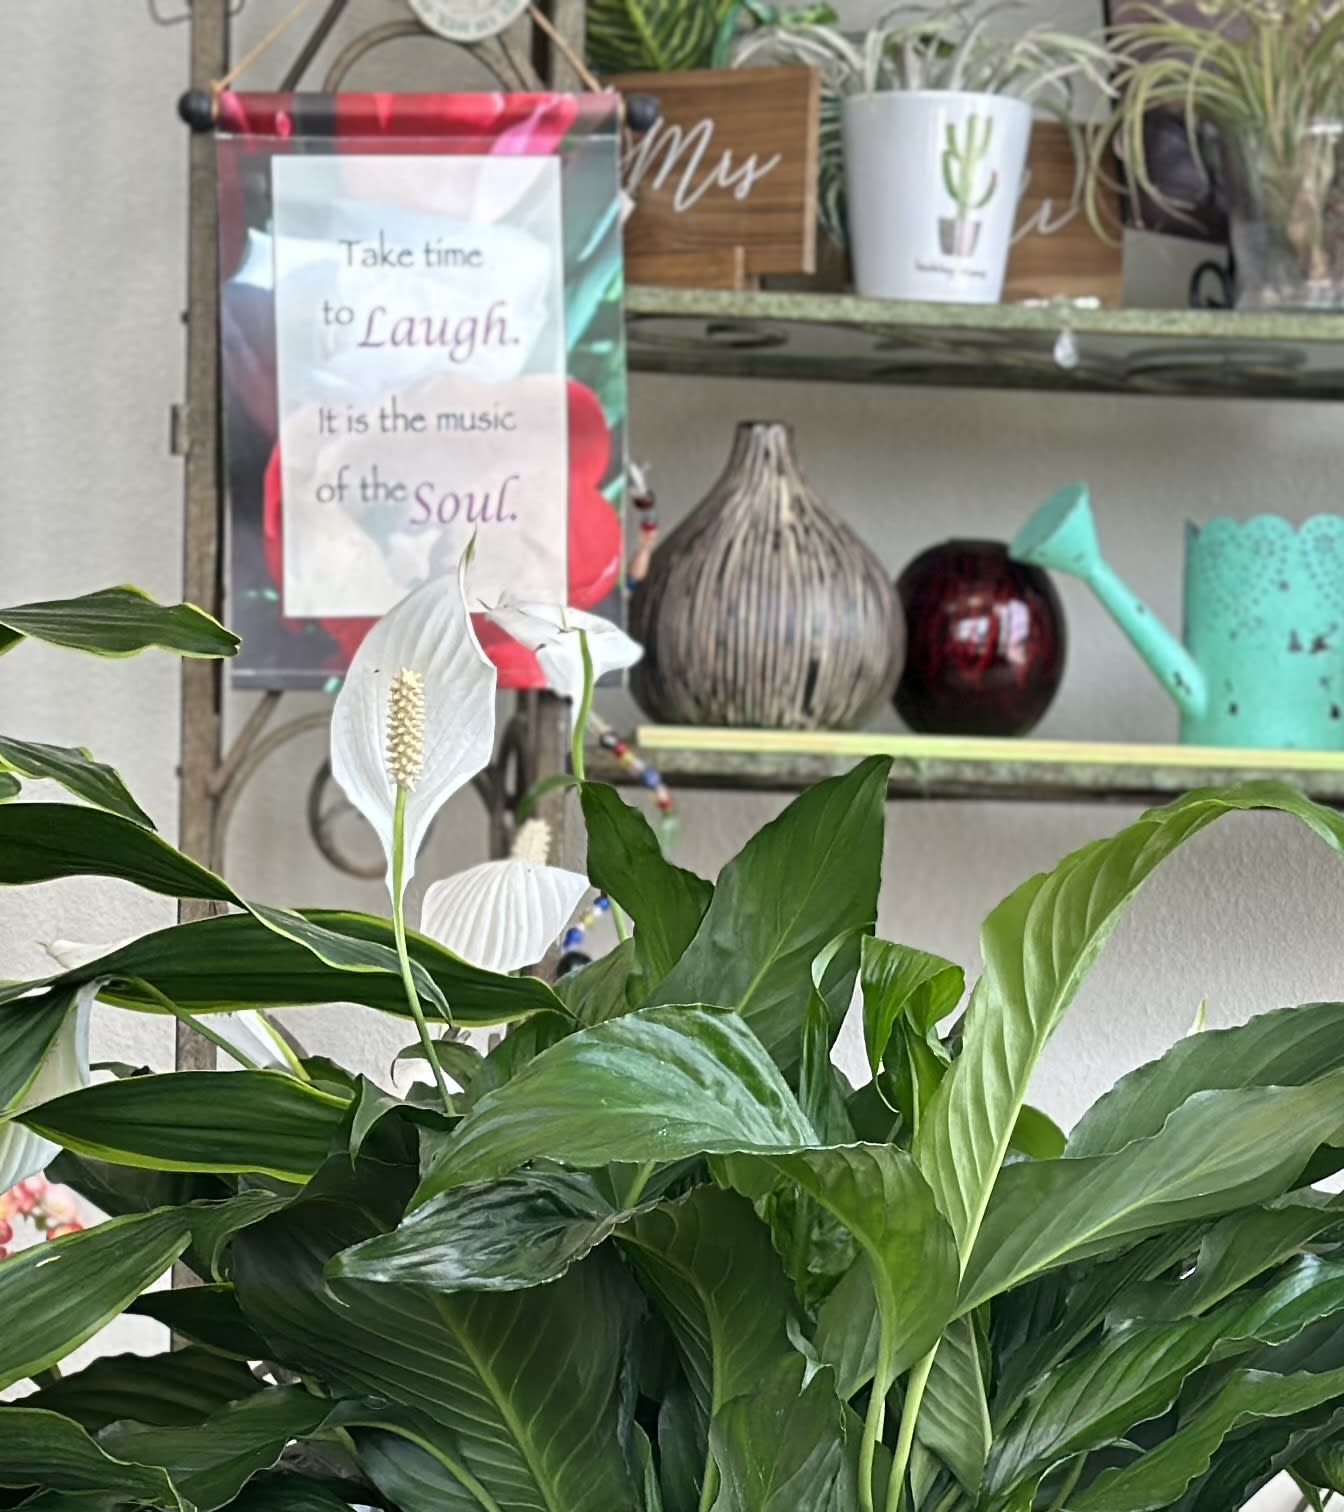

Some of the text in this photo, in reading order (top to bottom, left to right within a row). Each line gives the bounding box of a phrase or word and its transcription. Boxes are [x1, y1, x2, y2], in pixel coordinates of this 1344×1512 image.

[625, 116, 783, 214] Mrs
[338, 228, 484, 268] Take time
[322, 300, 521, 364] to Laugh.
[318, 395, 517, 435] It is the music
[316, 463, 521, 526] of the Soul.
